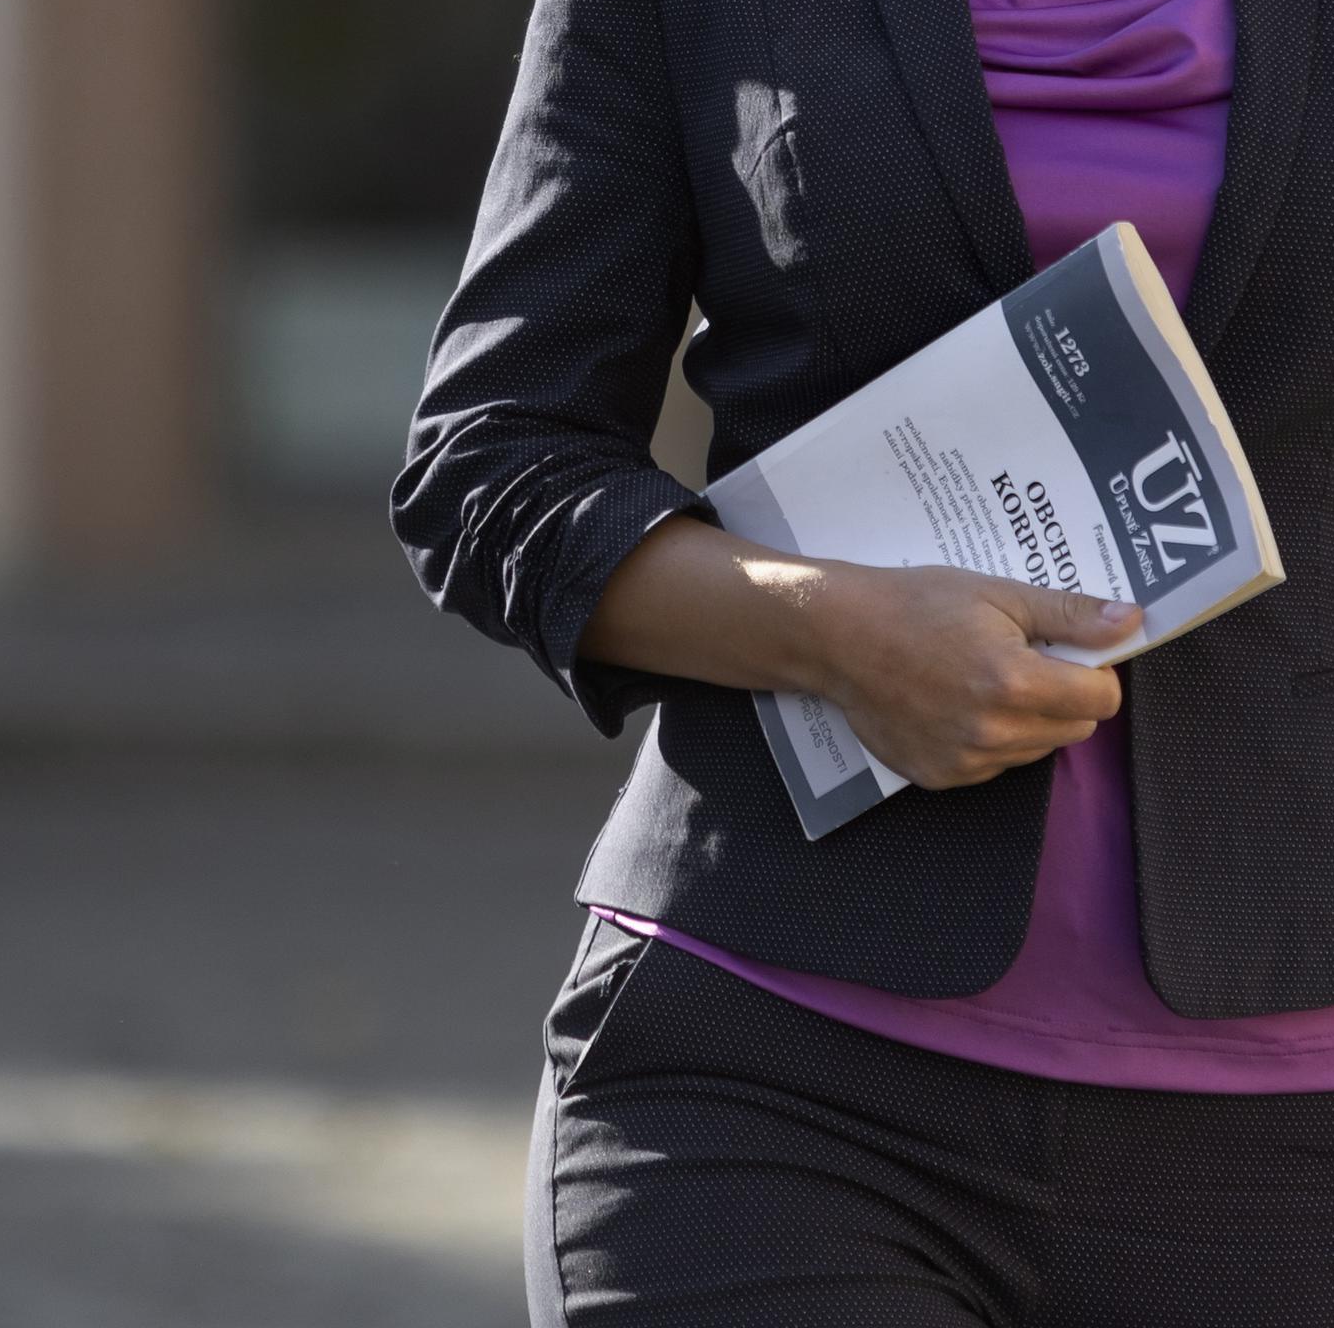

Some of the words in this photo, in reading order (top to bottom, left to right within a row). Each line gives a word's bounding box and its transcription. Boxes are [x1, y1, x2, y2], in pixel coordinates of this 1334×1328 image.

[1055, 327, 1089, 376] 1273
[883, 430, 904, 460] státní
[899, 460, 923, 499] podnik,
[923, 500, 944, 539] všechny
[895, 425, 924, 471] evropská
[921, 472, 951, 527] společnost,
[938, 474, 964, 522] Evropské
[939, 451, 964, 491] nabídky
[959, 493, 985, 538] převzetí,
[950, 448, 979, 492] přeměny
[977, 494, 1005, 551] obchodních
